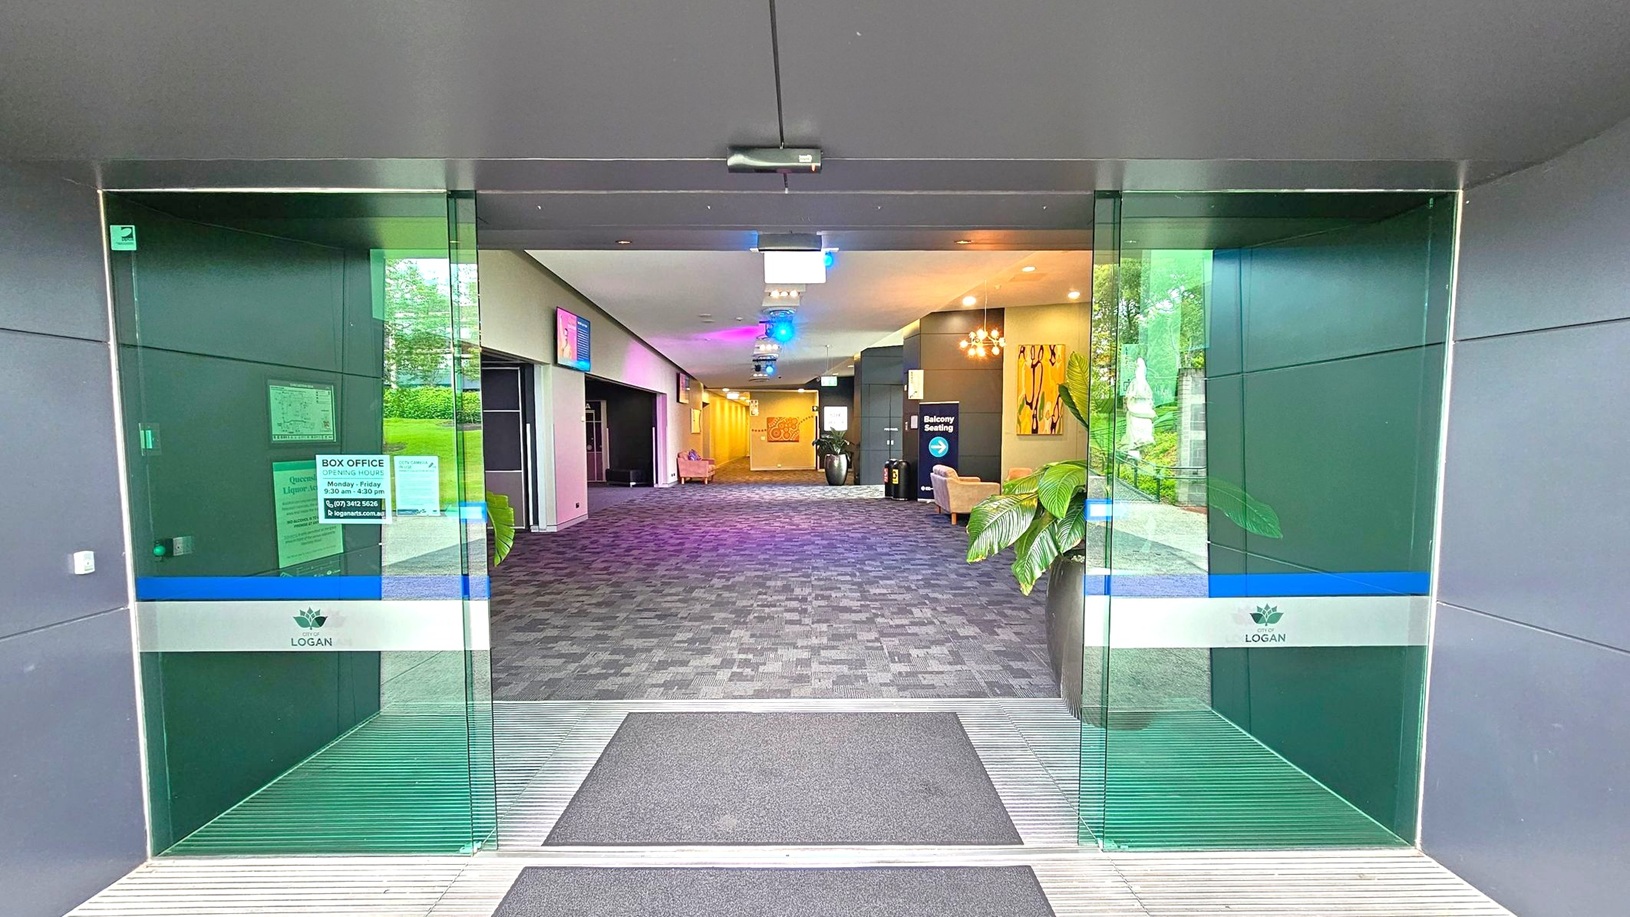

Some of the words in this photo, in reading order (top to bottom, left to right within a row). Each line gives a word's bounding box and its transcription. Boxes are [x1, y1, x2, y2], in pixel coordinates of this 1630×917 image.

[924, 416, 954, 424] Balcony
[924, 424, 953, 432] Seating
[322, 459, 344, 467] BOX
[347, 459, 384, 467] OFFICE
[290, 474, 317, 484] Queensl
[283, 486, 307, 495] Liquor
[291, 638, 332, 646] LOGAN
[1245, 634, 1286, 642] LOGAN
